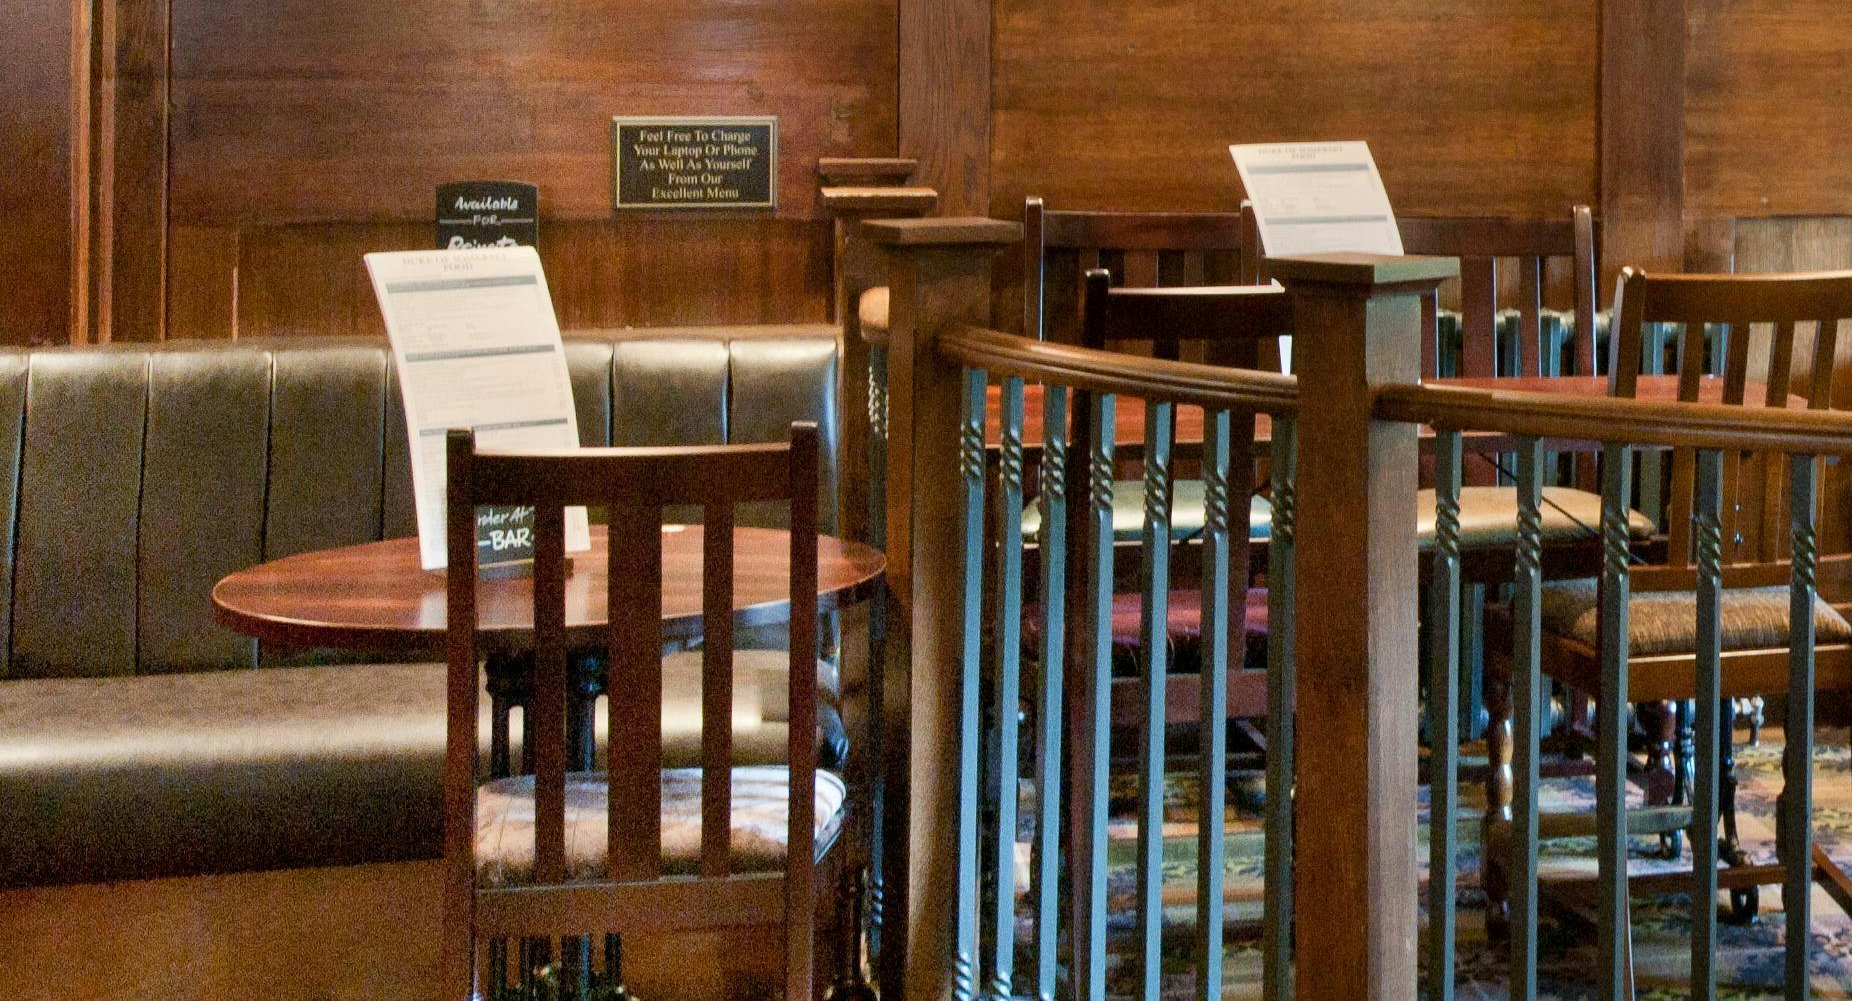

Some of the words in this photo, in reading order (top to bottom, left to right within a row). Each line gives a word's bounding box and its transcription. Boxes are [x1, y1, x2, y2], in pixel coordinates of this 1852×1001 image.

[640, 130, 663, 142] Feel
[668, 130, 691, 142] Free
[696, 130, 709, 142] To
[711, 130, 751, 144] Charge
[633, 144, 660, 156] Your
[664, 144, 703, 158] Laptop
[705, 144, 720, 156] Or
[723, 144, 758, 156] Phone
[640, 159, 655, 171] As
[658, 159, 683, 170] Well
[686, 159, 702, 170] As
[705, 158, 752, 170] Yourself
[668, 173, 698, 184] From
[701, 173, 723, 184] Our
[652, 187, 703, 199] Excellent
[707, 187, 739, 199] Menu
[454, 196, 519, 211] Available
[478, 508, 509, 526] rder
[490, 528, 531, 550] BAR
